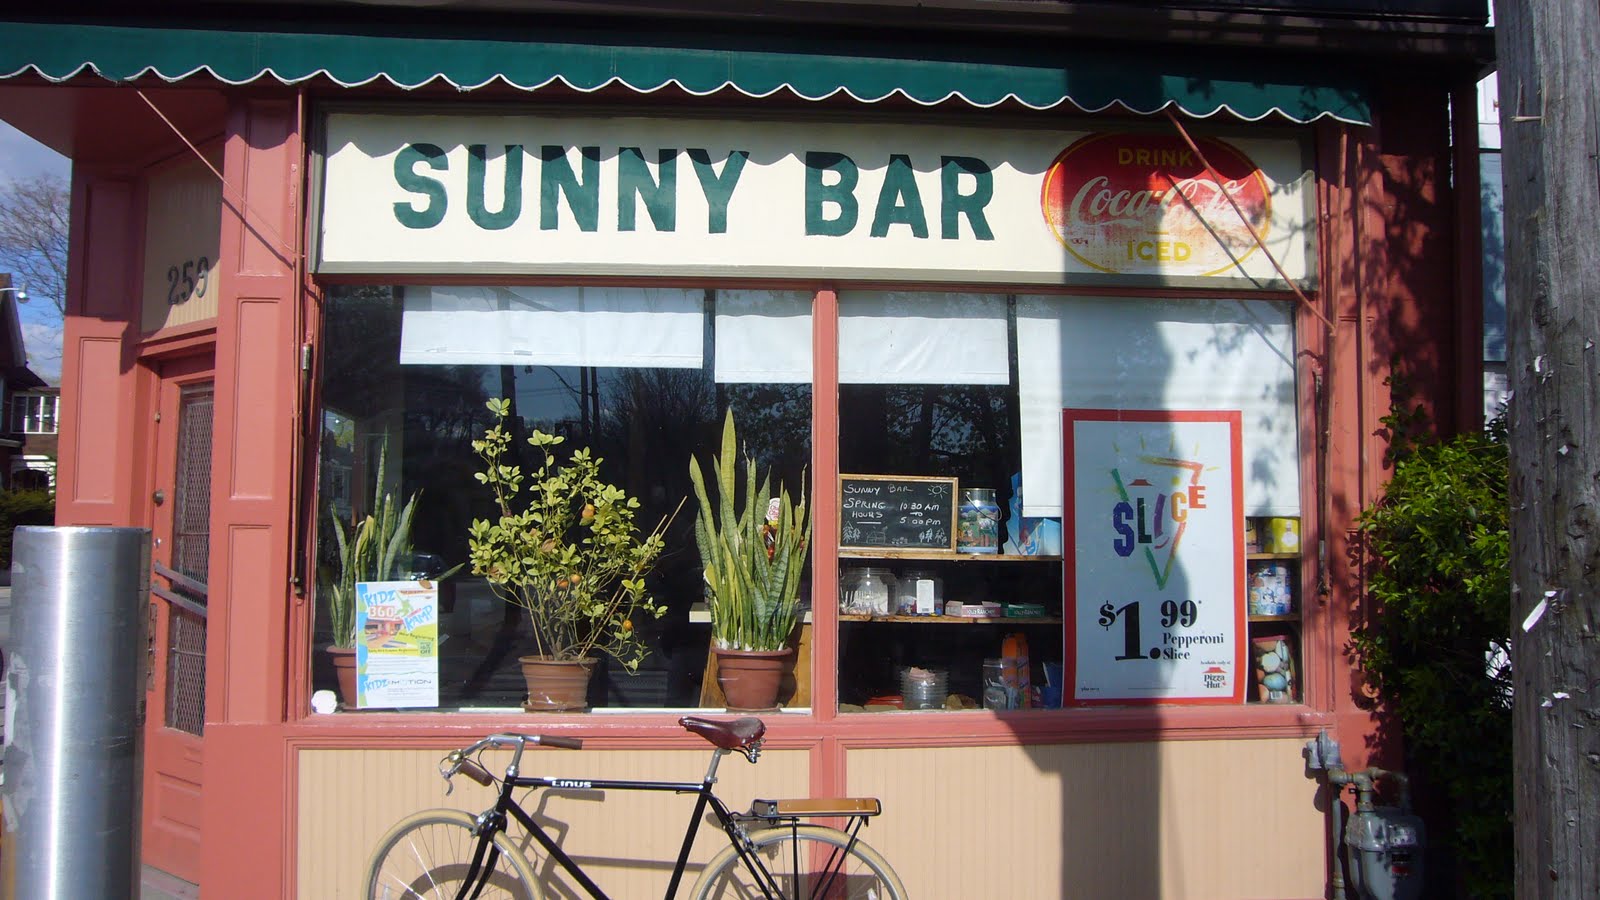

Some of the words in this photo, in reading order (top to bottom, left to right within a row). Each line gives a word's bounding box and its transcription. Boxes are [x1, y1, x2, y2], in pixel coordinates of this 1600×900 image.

[1118, 149, 1194, 166] DRINK
[393, 143, 750, 234] SUNNY
[805, 151, 995, 241] BAR
[1127, 241, 1192, 262] ICED
[168, 256, 209, 305] 259
[888, 484, 914, 493] BAR
[843, 498, 887, 510] SPRING
[852, 511, 883, 519] HOURS
[1112, 485, 1207, 557] SLICE
[364, 590, 396, 607] KIDZ
[1163, 632, 1224, 648] Pepperoni
[1163, 647, 1191, 660] Slice
[1204, 674, 1225, 682] Pizza
